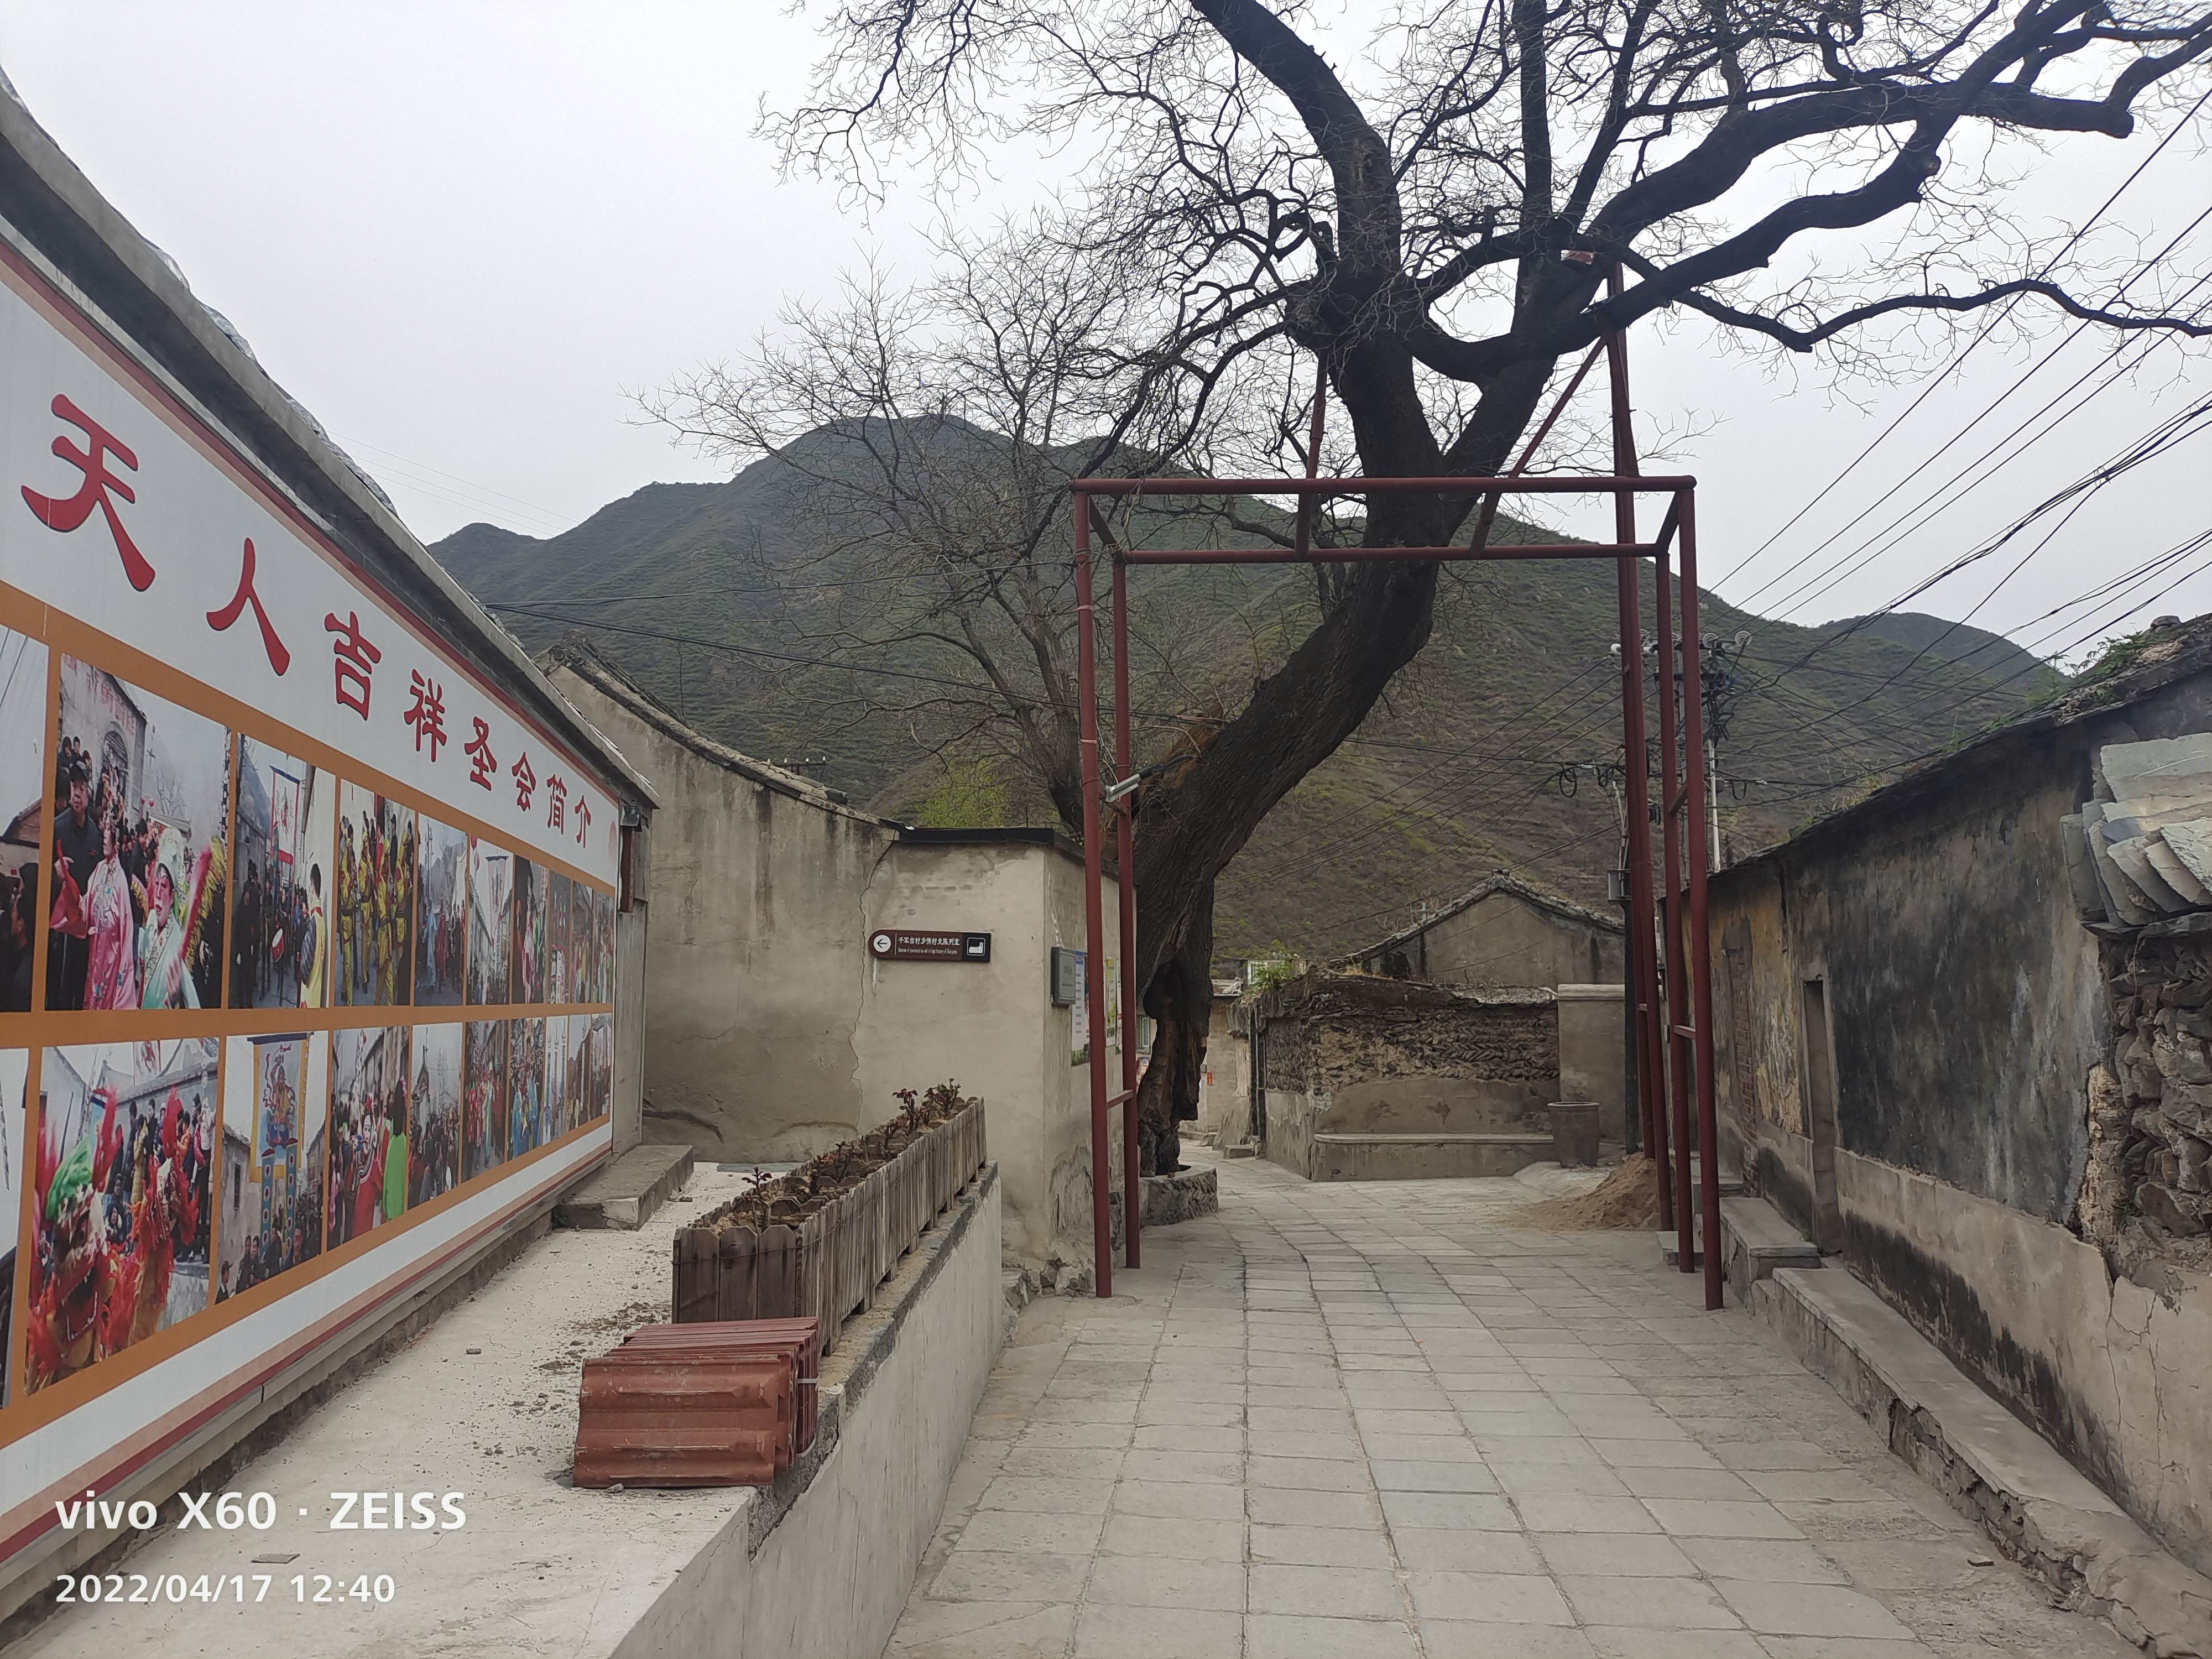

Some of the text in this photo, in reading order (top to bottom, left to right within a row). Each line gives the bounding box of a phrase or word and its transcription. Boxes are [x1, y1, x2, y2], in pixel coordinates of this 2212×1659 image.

[21, 394, 591, 850] 天人吉祥圣会简介
